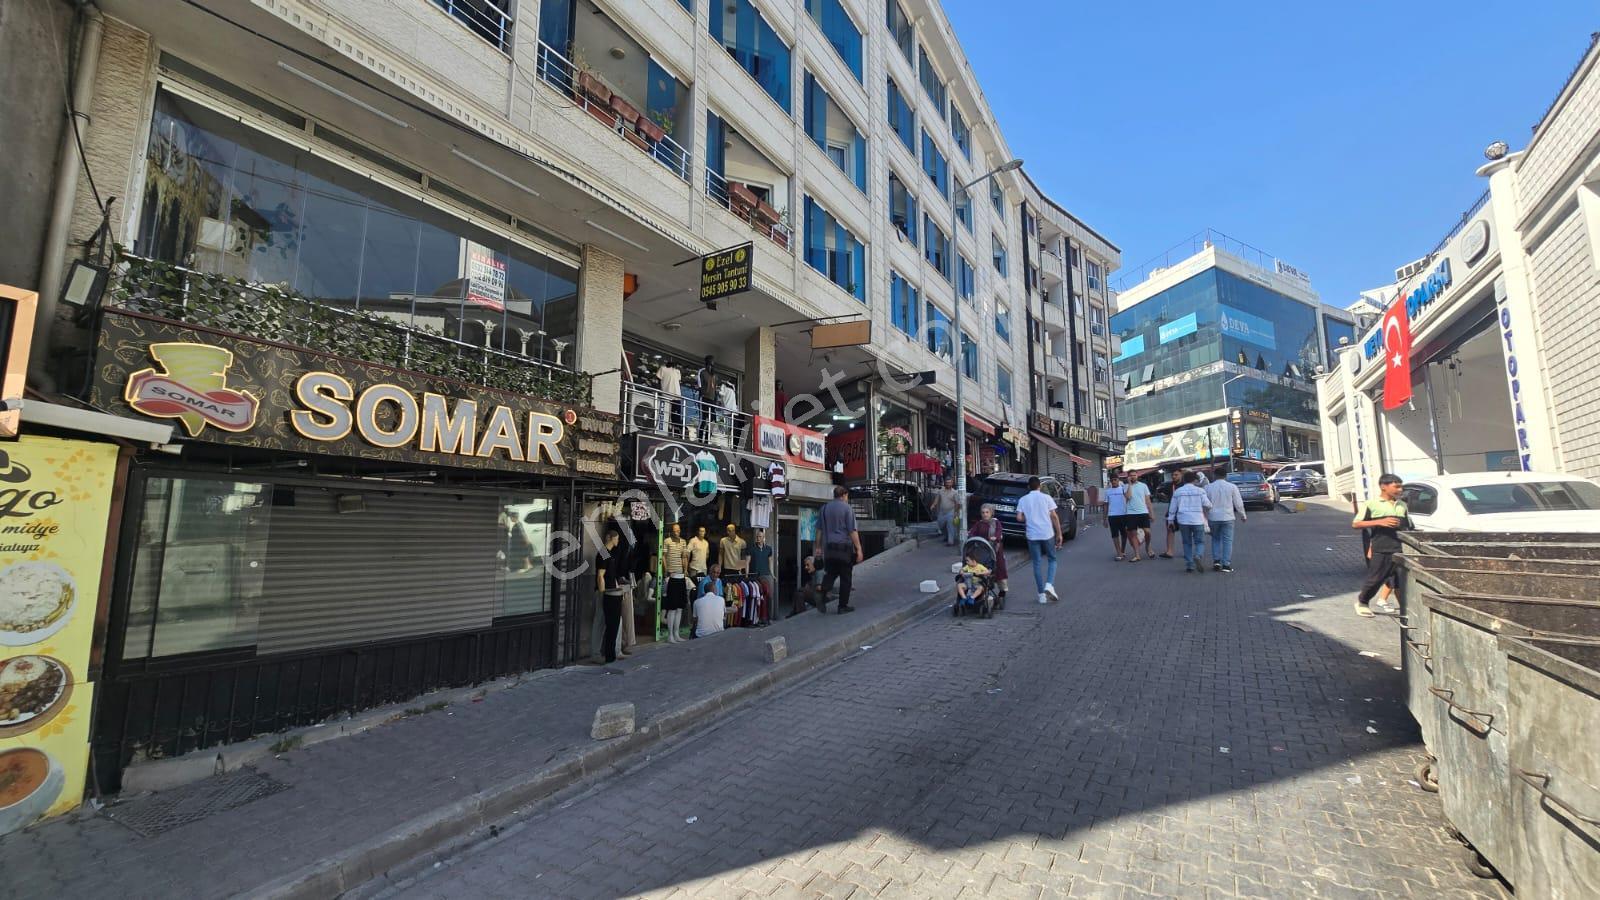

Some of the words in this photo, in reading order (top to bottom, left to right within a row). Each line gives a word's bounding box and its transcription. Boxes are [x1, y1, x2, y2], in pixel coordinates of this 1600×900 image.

[716, 252, 733, 268] Ezel
[703, 271, 721, 285] Mersin
[724, 263, 748, 279] Tantuni
[702, 284, 716, 298] 0545
[717, 281, 728, 294] 905
[730, 279, 738, 291] 90
[738, 276, 747, 289] 33
[1229, 318, 1249, 334] DEVA
[1501, 307, 1531, 472] OTOPARK
[151, 385, 236, 418] SOMAR
[291, 371, 566, 465] SOMAR
[806, 441, 823, 459] SPOR
[576, 459, 616, 475] BURGER
[653, 459, 692, 481] WDJ
[1, 522, 60, 540] midye
